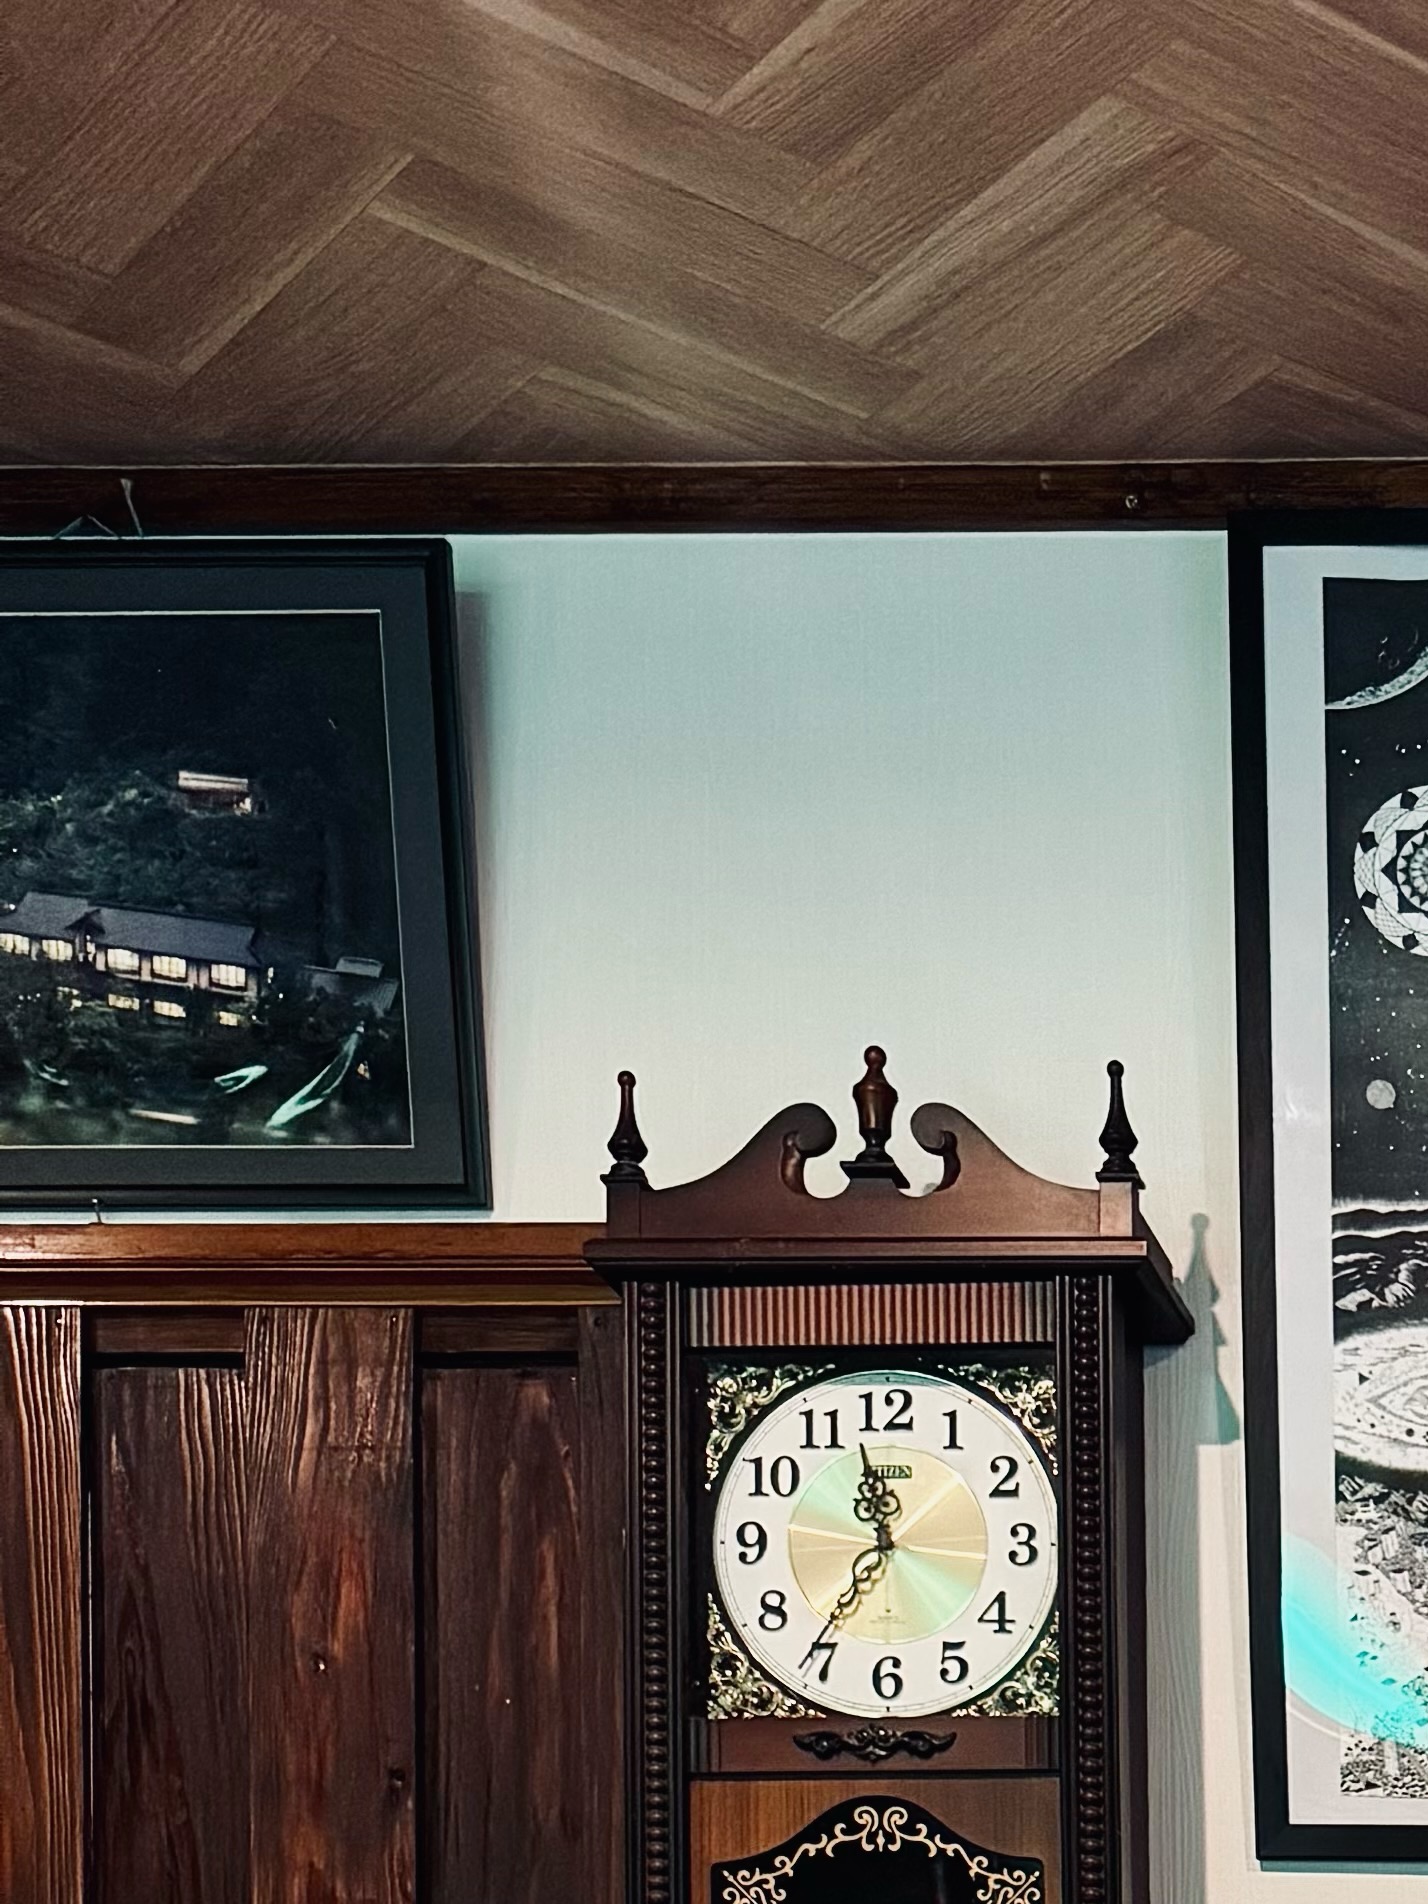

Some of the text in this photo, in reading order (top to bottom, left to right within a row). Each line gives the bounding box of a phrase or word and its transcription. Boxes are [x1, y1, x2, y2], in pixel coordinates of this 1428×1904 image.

[799, 1409, 846, 1450] 11
[858, 1389, 914, 1432] 12
[942, 1409, 964, 1450] 1
[742, 1455, 800, 1498] 10
[988, 1455, 1021, 1499] 2
[736, 1521, 768, 1565] 9
[1008, 1523, 1039, 1566] 3
[758, 1590, 788, 1631] 8
[977, 1591, 1017, 1635] 4
[809, 1641, 839, 1683] 7
[872, 1656, 904, 1699] 6
[939, 1640, 970, 1683] 5
